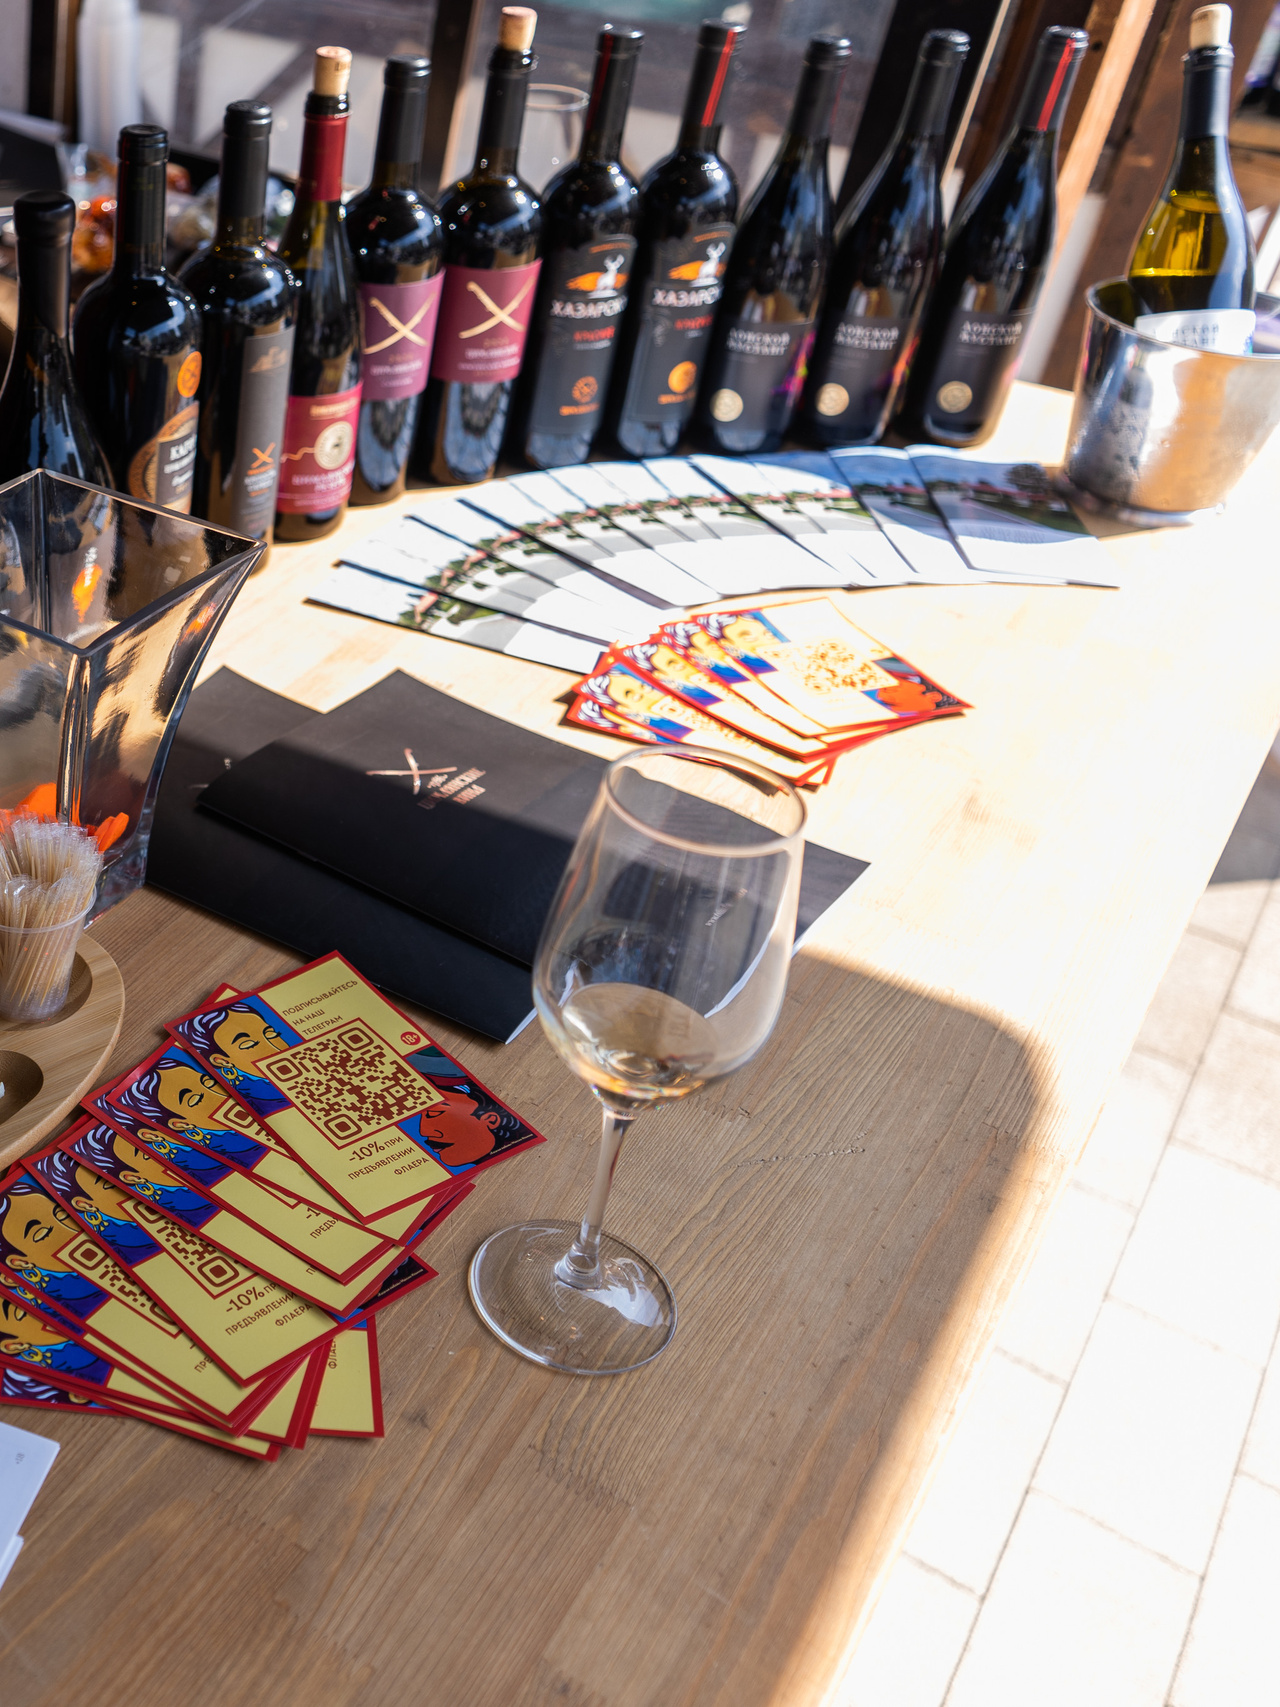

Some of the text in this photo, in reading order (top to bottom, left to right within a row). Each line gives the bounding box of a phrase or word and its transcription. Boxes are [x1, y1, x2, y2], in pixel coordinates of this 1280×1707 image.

[282, 979, 359, 1017] ПОДПИСЫВАЙТЕСЬ
[292, 1008, 326, 1027] НА НАШ
[302, 1015, 344, 1036] ТЕЛЕГРАМ
[402, 1033, 419, 1046] 18+
[348, 1136, 404, 1163] -10% ПРИ
[348, 1146, 416, 1181] ПРЕДЪЯВЛЕНИИ
[394, 1156, 430, 1176] ФЛАЕРА
[226, 1286, 265, 1313] -10%
[274, 1302, 314, 1327] ФЛАЕРА
